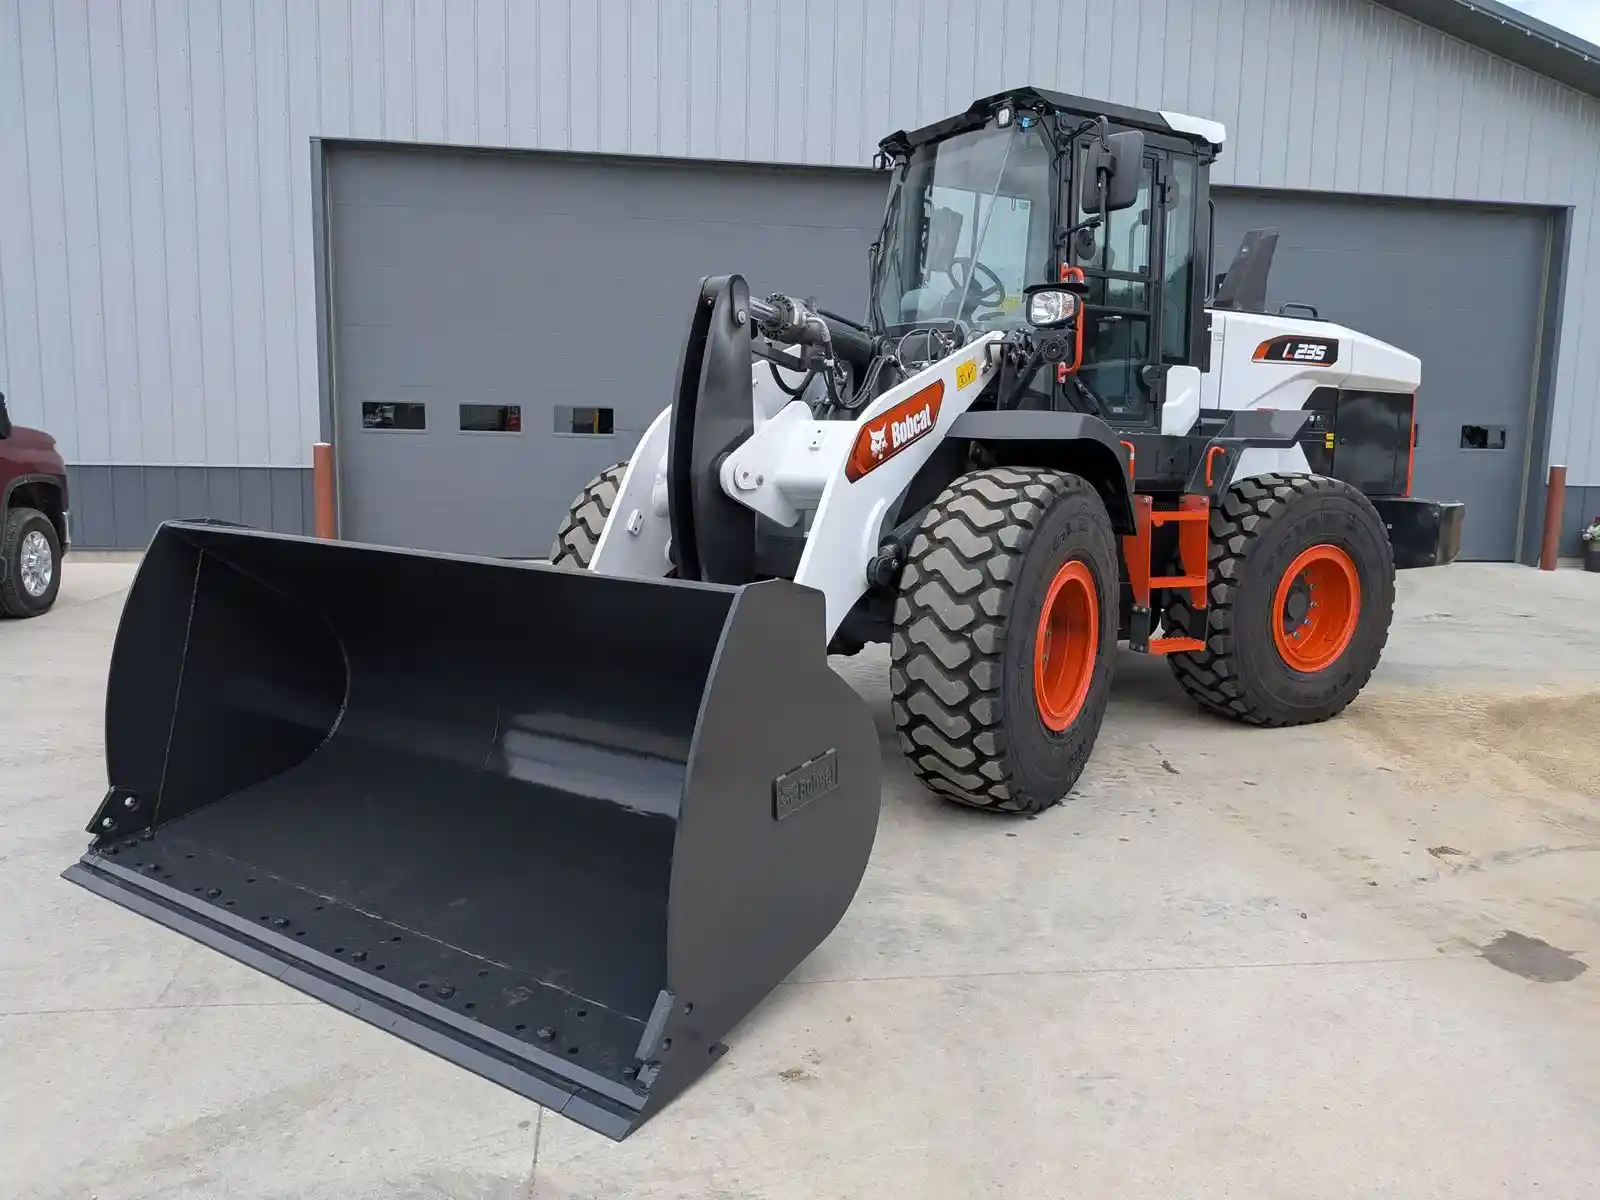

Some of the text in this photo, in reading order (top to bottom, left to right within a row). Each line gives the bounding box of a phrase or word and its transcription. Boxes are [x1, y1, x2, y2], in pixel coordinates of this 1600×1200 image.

[1282, 342, 1327, 360] L 235
[891, 403, 931, 448] Bobcat
